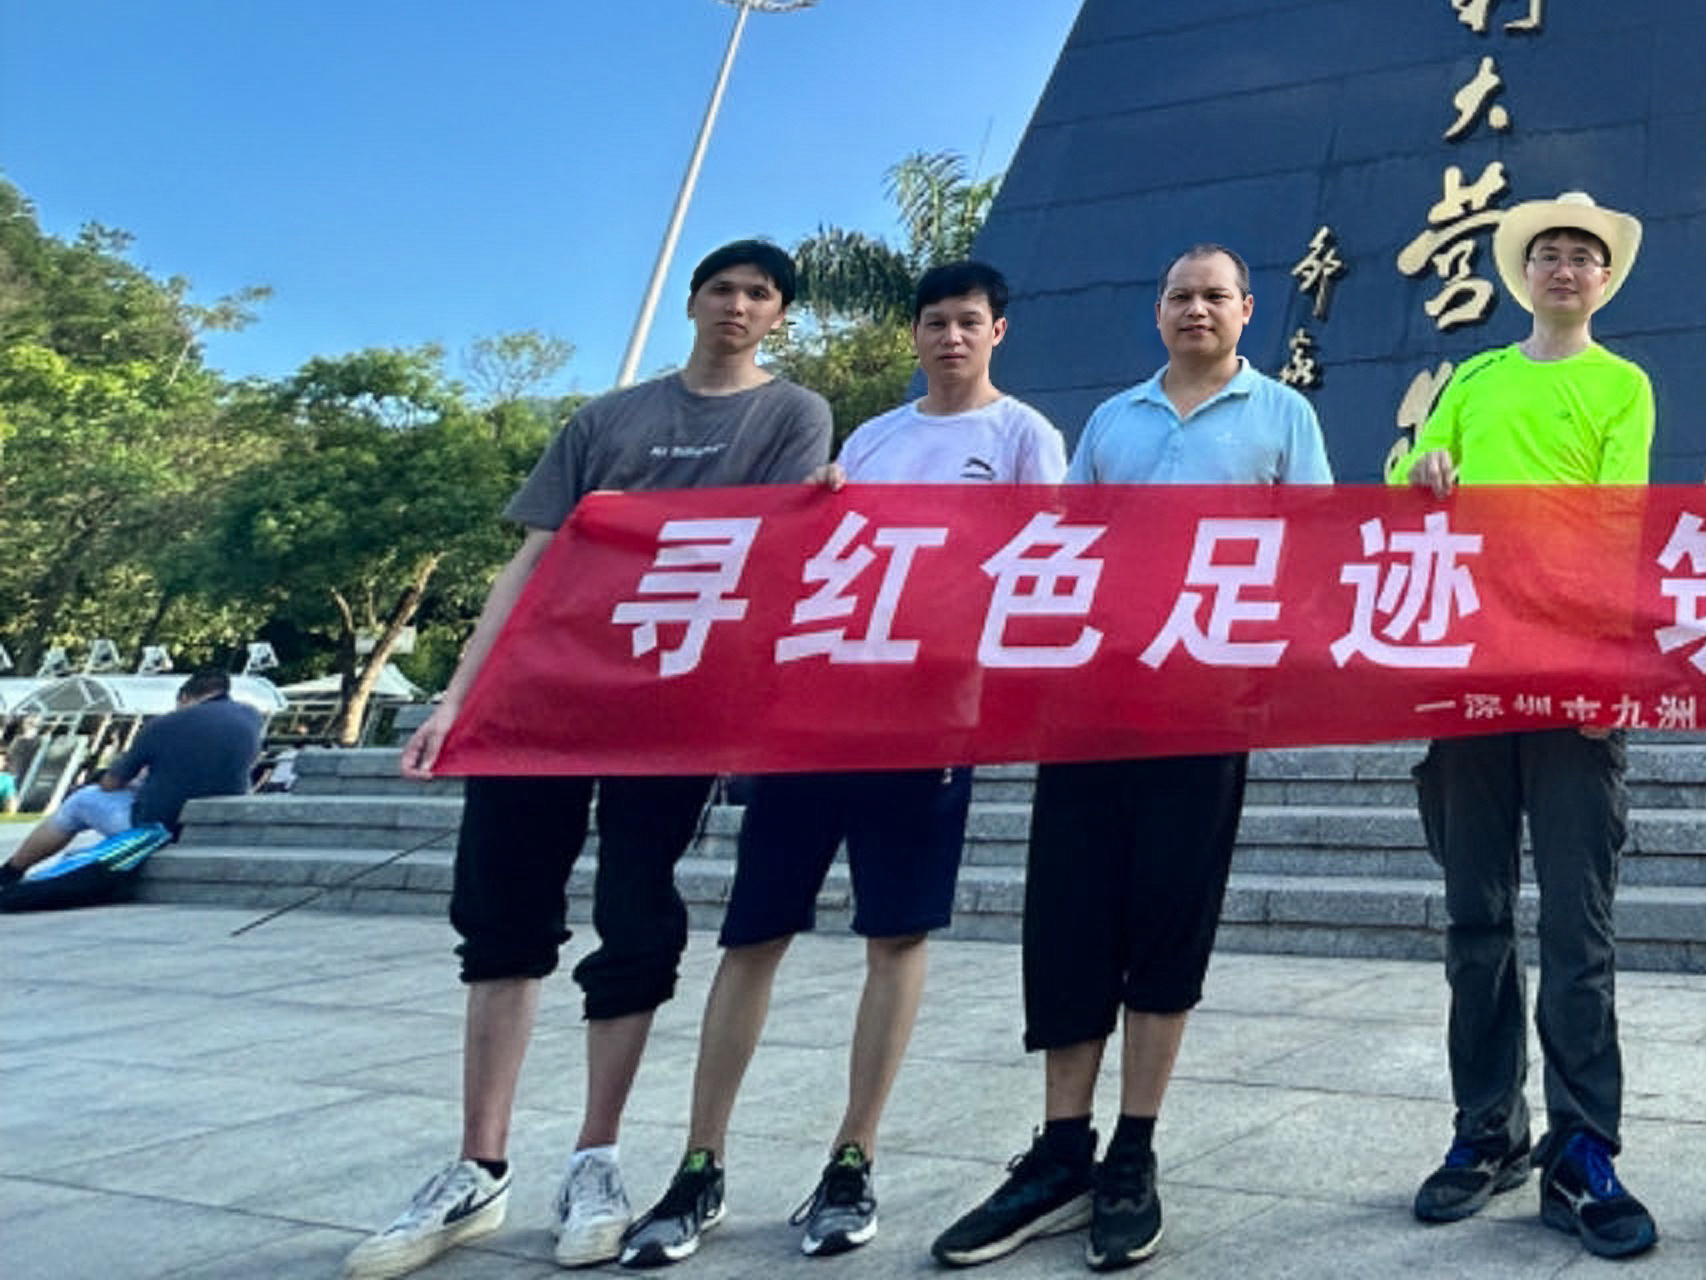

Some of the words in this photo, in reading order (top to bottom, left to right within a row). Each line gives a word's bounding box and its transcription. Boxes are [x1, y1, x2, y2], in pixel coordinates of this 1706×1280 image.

[611, 510, 1483, 678] 寻红色足迹
